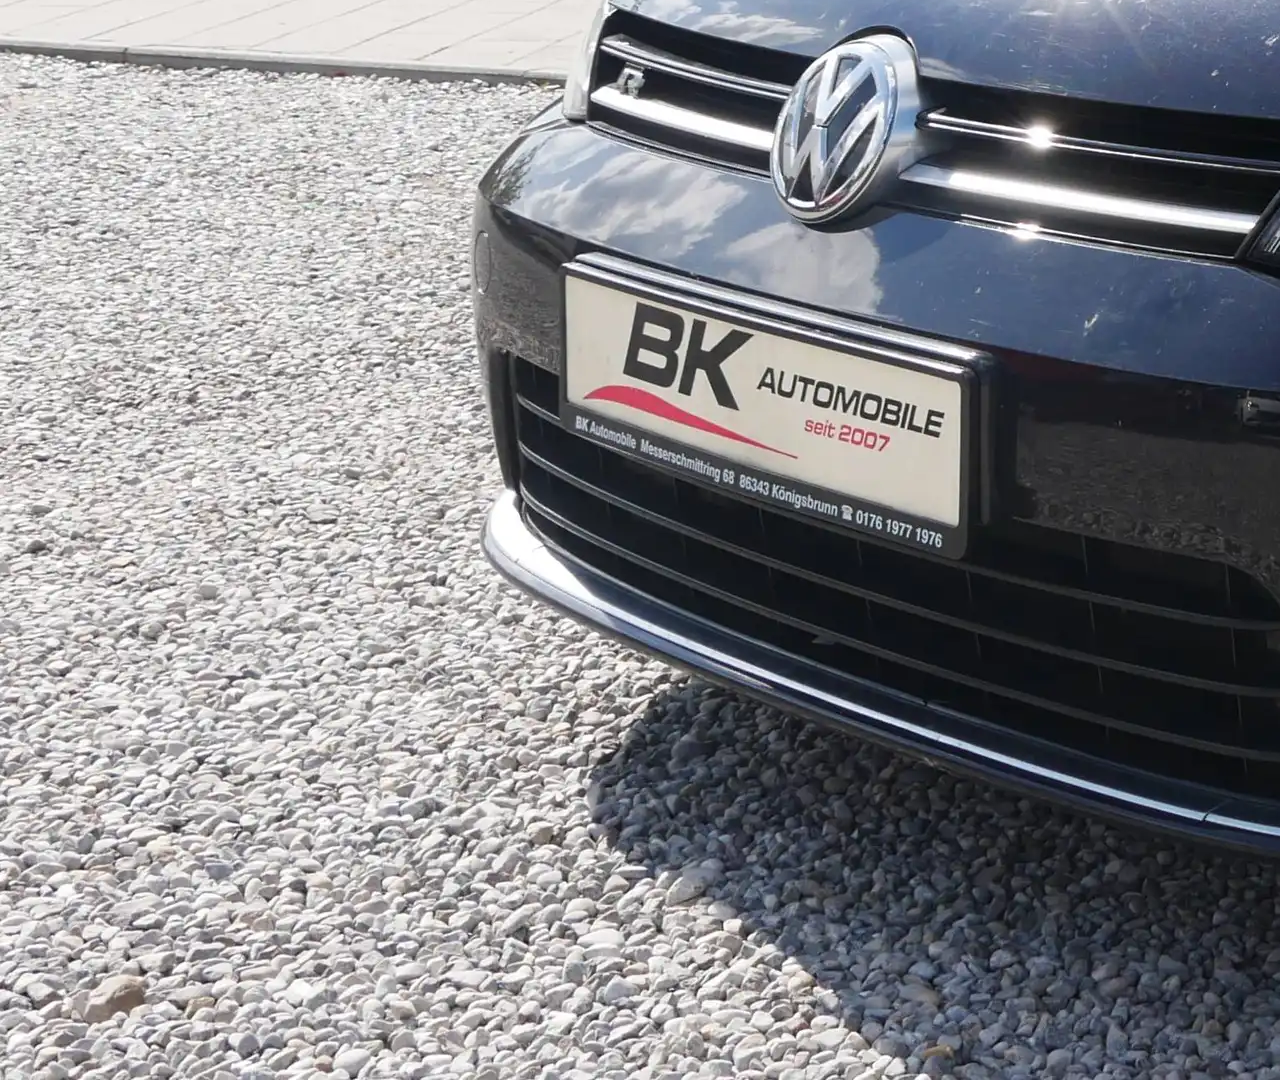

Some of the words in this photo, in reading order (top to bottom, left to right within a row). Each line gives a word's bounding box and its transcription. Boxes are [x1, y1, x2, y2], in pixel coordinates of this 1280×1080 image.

[623, 301, 755, 411] BK
[757, 367, 945, 438] AUTOMOBILE
[804, 419, 836, 439] seit
[838, 425, 891, 452] 2007
[575, 415, 588, 432] BK
[590, 422, 637, 449] Automobile
[640, 439, 721, 482] Messerschmittring
[722, 469, 735, 485] 68
[739, 474, 769, 496] 86343
[772, 484, 839, 517] Königsbrunn
[856, 511, 883, 530] 0176
[886, 519, 913, 538] 1977
[915, 528, 943, 548] 1976
